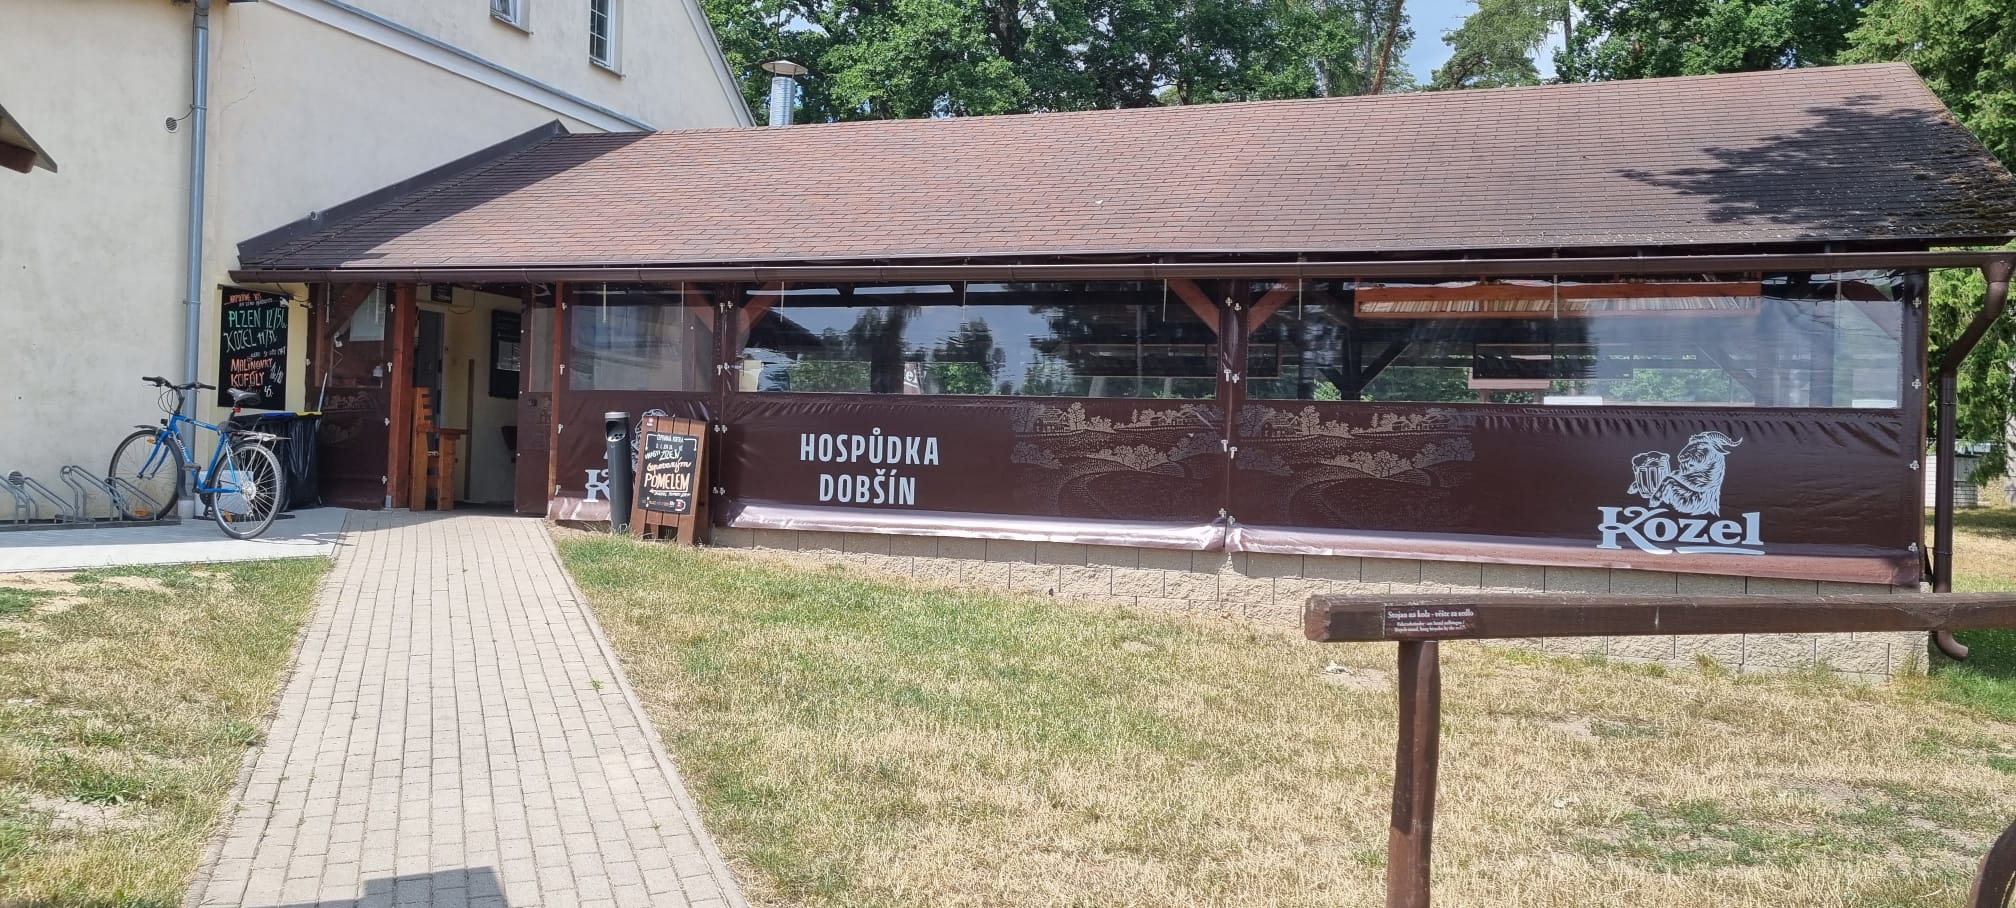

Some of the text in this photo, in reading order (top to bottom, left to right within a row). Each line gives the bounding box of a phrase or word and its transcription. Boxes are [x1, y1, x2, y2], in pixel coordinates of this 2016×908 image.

[223, 328, 257, 352] KOZEL
[800, 427, 939, 465] HOSPŮDKA
[644, 472, 691, 491] POMELEM
[819, 468, 916, 505] DOBŠÍN
[1597, 506, 1765, 554] Kozel
